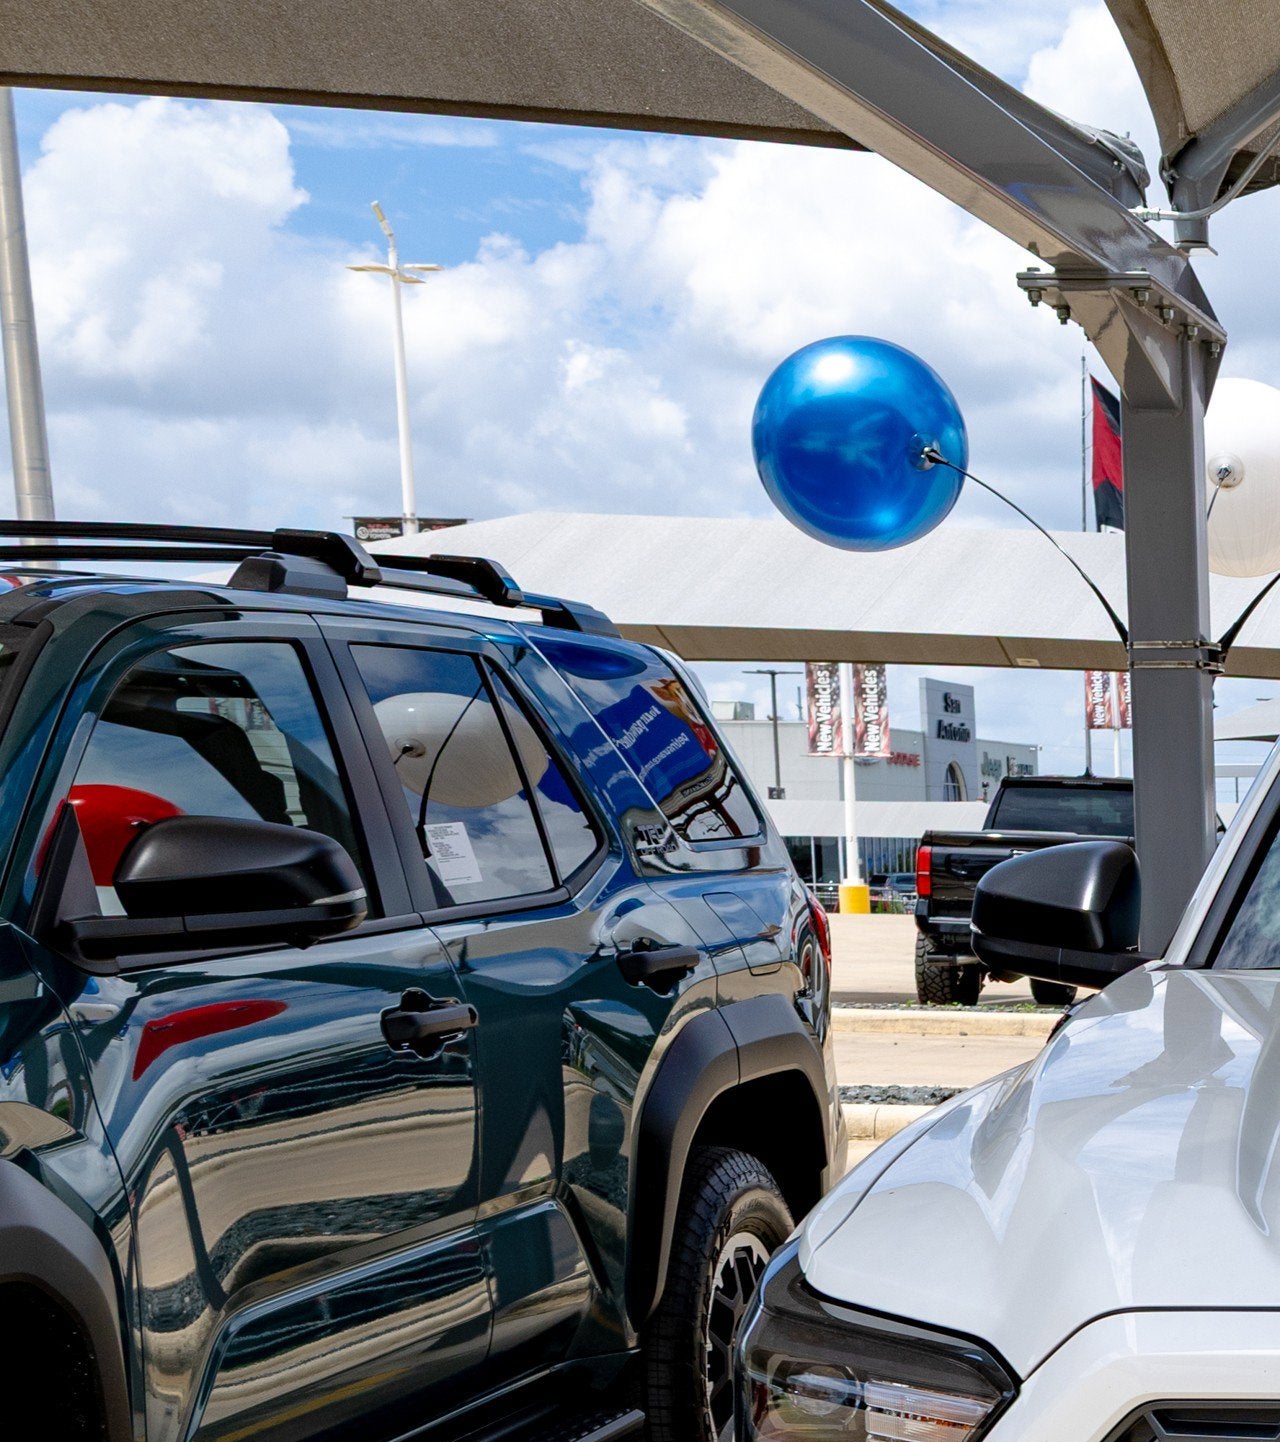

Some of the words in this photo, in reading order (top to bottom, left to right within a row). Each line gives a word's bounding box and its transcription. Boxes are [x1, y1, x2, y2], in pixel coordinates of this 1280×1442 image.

[815, 670, 831, 722] Vehicles
[862, 670, 879, 722] Vehicles
[1093, 705, 1105, 725] New
[817, 724, 832, 752] New
[865, 724, 880, 752] New
